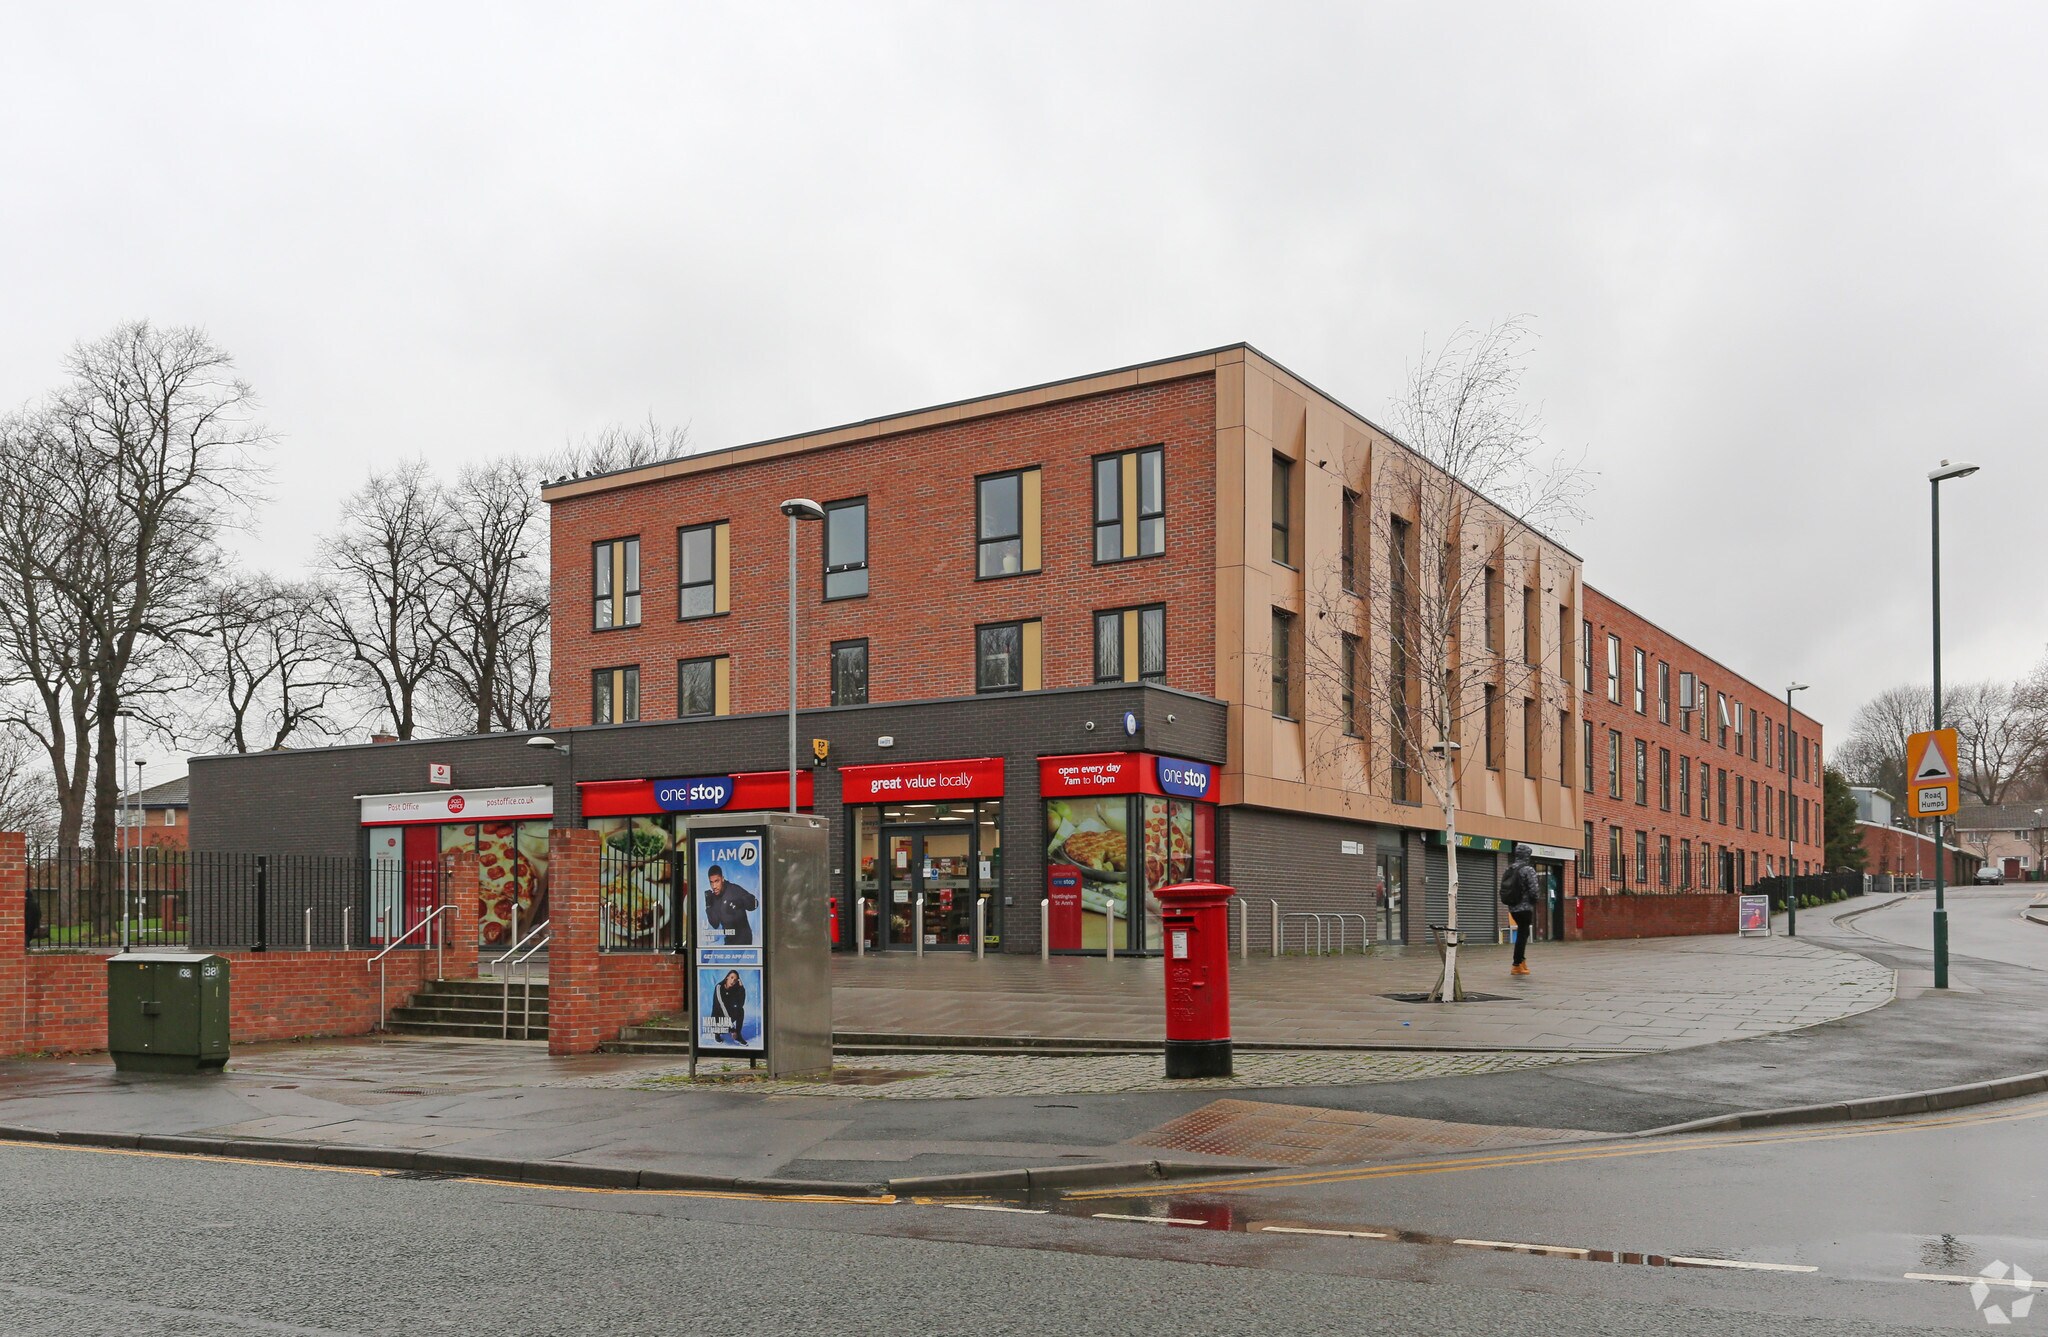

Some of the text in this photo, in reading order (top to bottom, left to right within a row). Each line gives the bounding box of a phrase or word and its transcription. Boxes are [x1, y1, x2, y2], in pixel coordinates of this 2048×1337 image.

[1058, 763, 1121, 776] open every day
[870, 772, 973, 793] great value locally
[1063, 774, 1115, 786] 7am to 10pm
[1163, 768, 1206, 792] one stop
[660, 783, 725, 804] one stop
[1924, 792, 1942, 800] Road
[388, 803, 419, 811] Post Office
[486, 796, 534, 808] postoffice.co.uk
[1454, 834, 1473, 847] UBWAY
[1483, 838, 1501, 850] SUBWAY
[711, 847, 755, 861] I AM JD
[204, 966, 216, 976] 38
